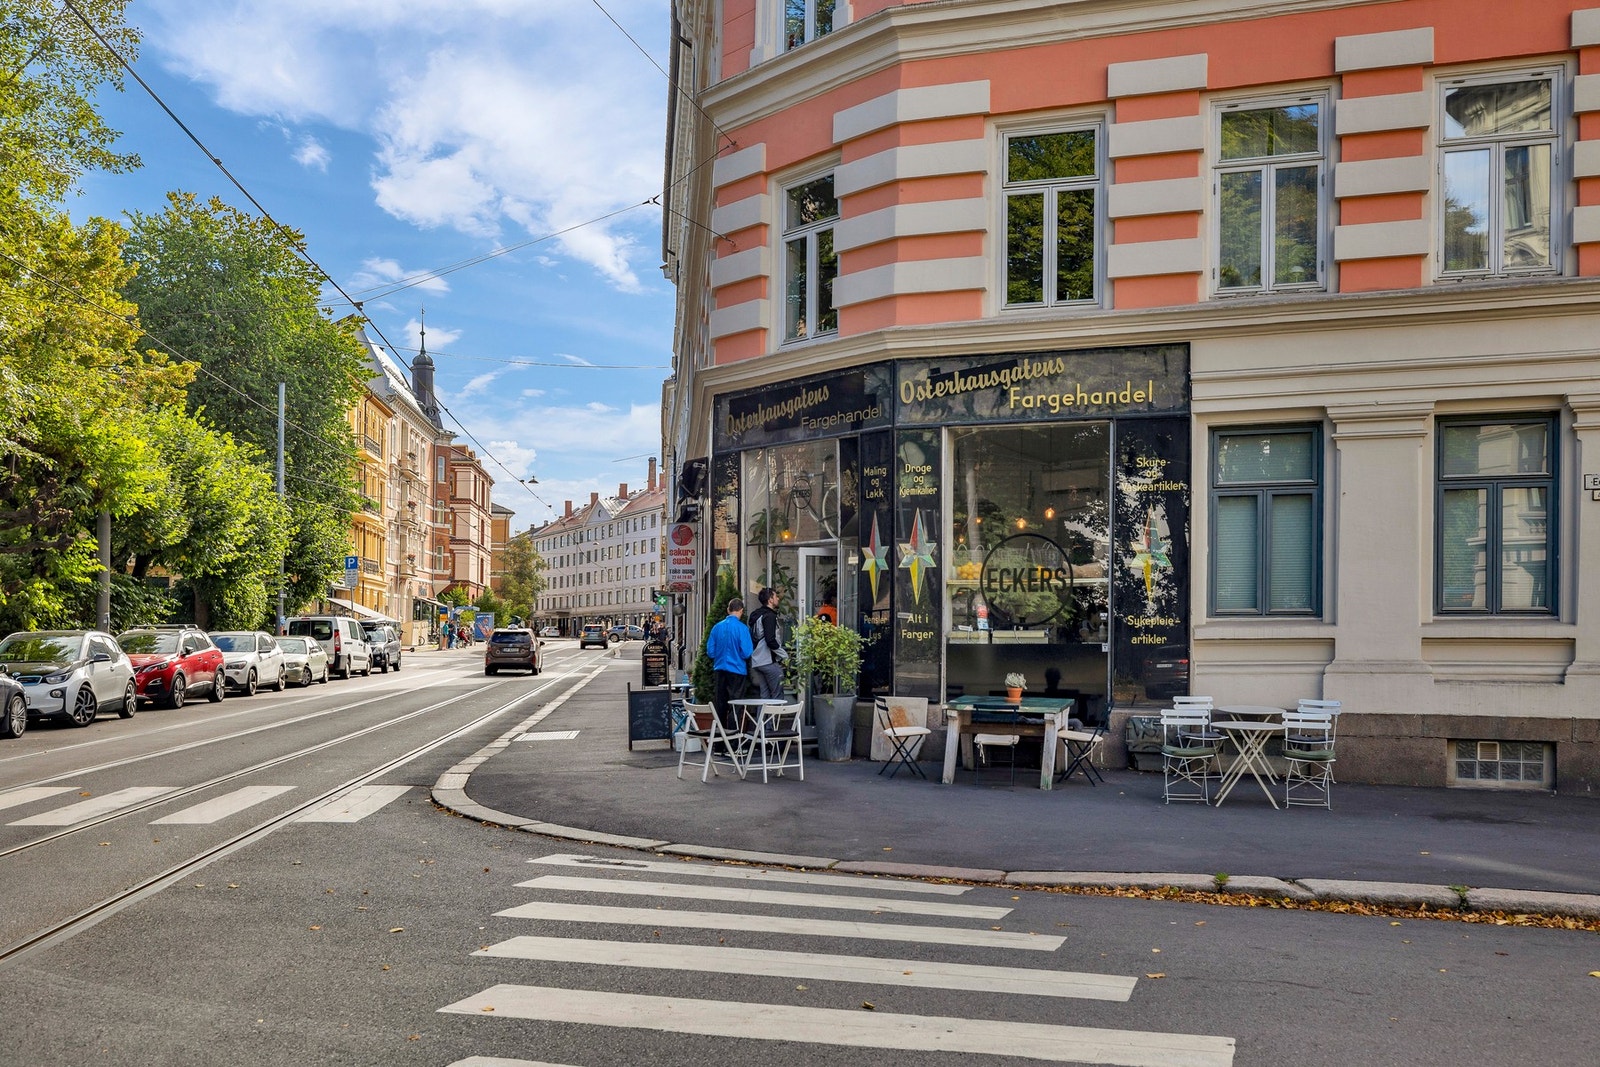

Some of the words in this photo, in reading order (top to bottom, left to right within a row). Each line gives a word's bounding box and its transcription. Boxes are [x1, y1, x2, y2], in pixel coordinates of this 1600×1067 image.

[1009, 379, 1153, 414] Fargehandel
[801, 404, 882, 430] Fargehandel
[1136, 456, 1171, 468] Skure-
[863, 466, 887, 477] Maling
[905, 463, 932, 474] Droge
[913, 475, 924, 485] og
[1146, 470, 1158, 480] og
[870, 478, 880, 487] og
[865, 488, 884, 499] Lakk
[899, 486, 937, 498] Kjemikalier
[669, 548, 695, 557] sakura
[348, 557, 355, 568] P
[672, 557, 692, 566] sushi
[986, 567, 1067, 593] ECKERS
[907, 613, 922, 624] Alt
[925, 613, 929, 624] i
[1127, 615, 1181, 628] Sykepleie-
[902, 629, 934, 641] Farger
[1131, 634, 1167, 644] artikler
